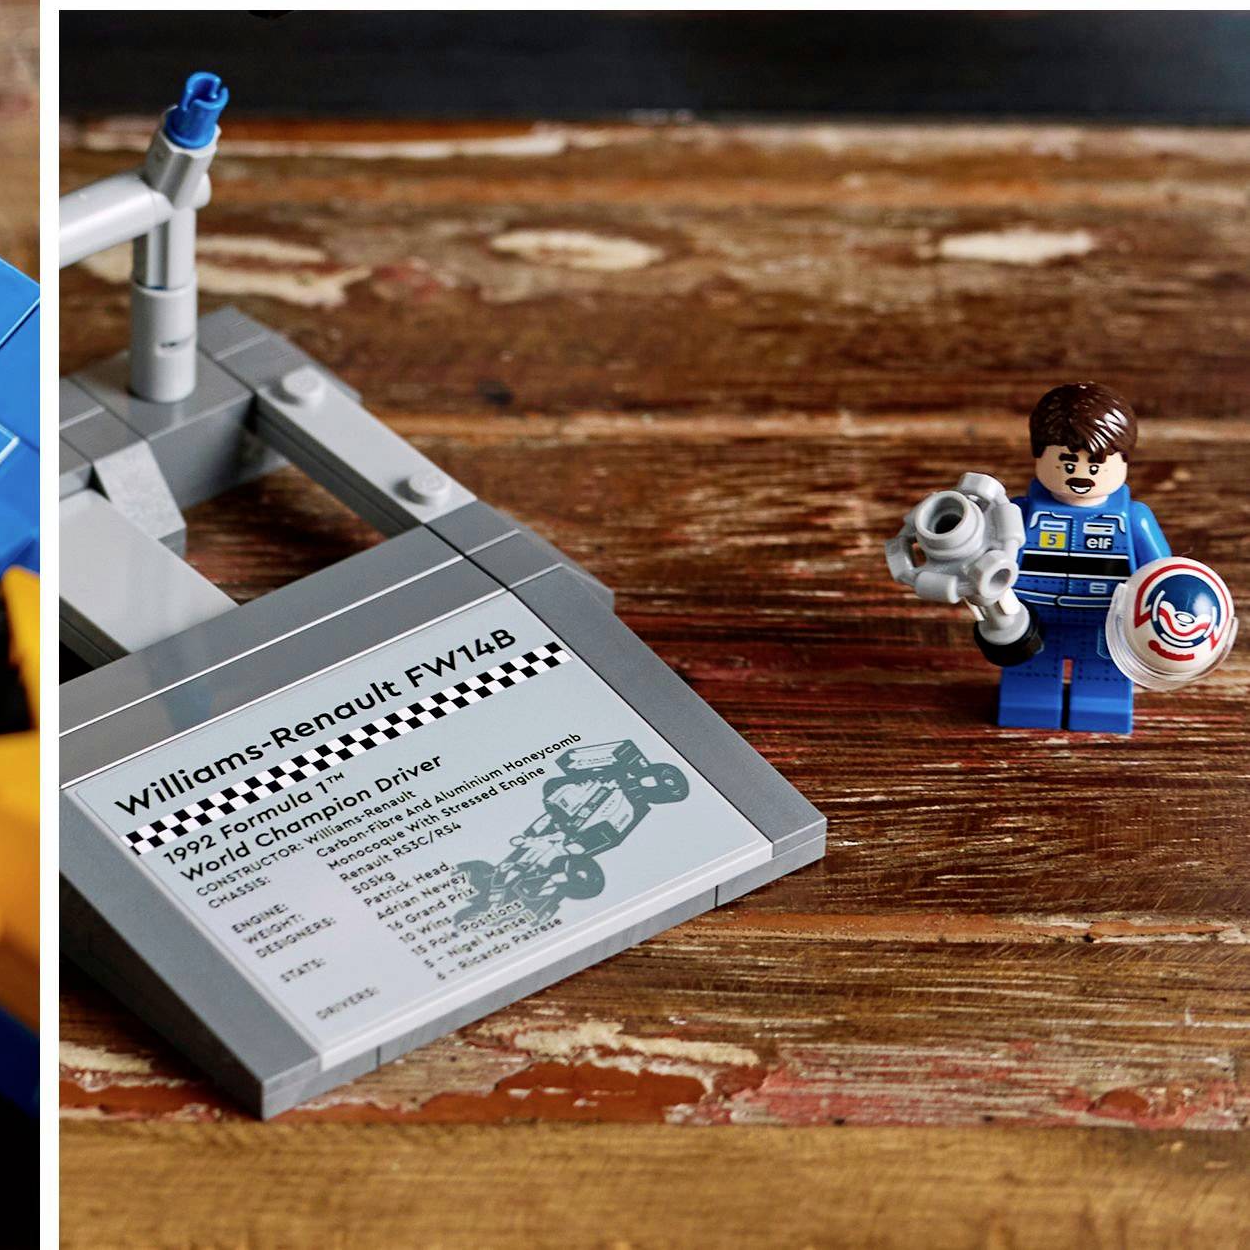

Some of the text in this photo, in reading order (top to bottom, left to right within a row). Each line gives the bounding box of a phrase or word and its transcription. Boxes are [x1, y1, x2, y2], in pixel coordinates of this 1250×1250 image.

[1047, 534, 1112, 549] 5 elf
[114, 629, 516, 817] Williams-Renault FW14B
[164, 835, 217, 866] 1992
[220, 789, 312, 840] Formula
[180, 755, 441, 882] World Champion Driver
[196, 790, 417, 897] CONSTRUCTOR: Williams-Renault
[208, 733, 582, 908] CHASSIS: Carbon-Fibre And Aluminium Honeycomb
[326, 766, 546, 870] Monocoque With Stressed Engine
[231, 903, 289, 934] ENGINE:
[339, 854, 394, 882] Renault
[243, 871, 397, 944] WEIGHT: 505kg
[255, 861, 455, 958] DESIGNERS: Patrick Head,
[377, 873, 467, 921] Adrian Newey
[387, 920, 404, 932] 16
[405, 900, 447, 924] Grand
[447, 886, 476, 905] Prix
[399, 915, 452, 945] 10 Wins
[429, 930, 458, 949] Pole
[460, 900, 523, 934] Positions
[448, 935, 482, 958] Nigel
[484, 912, 535, 940] Mansell
[458, 943, 510, 970] Ricardo
[511, 917, 563, 946] Patrese
